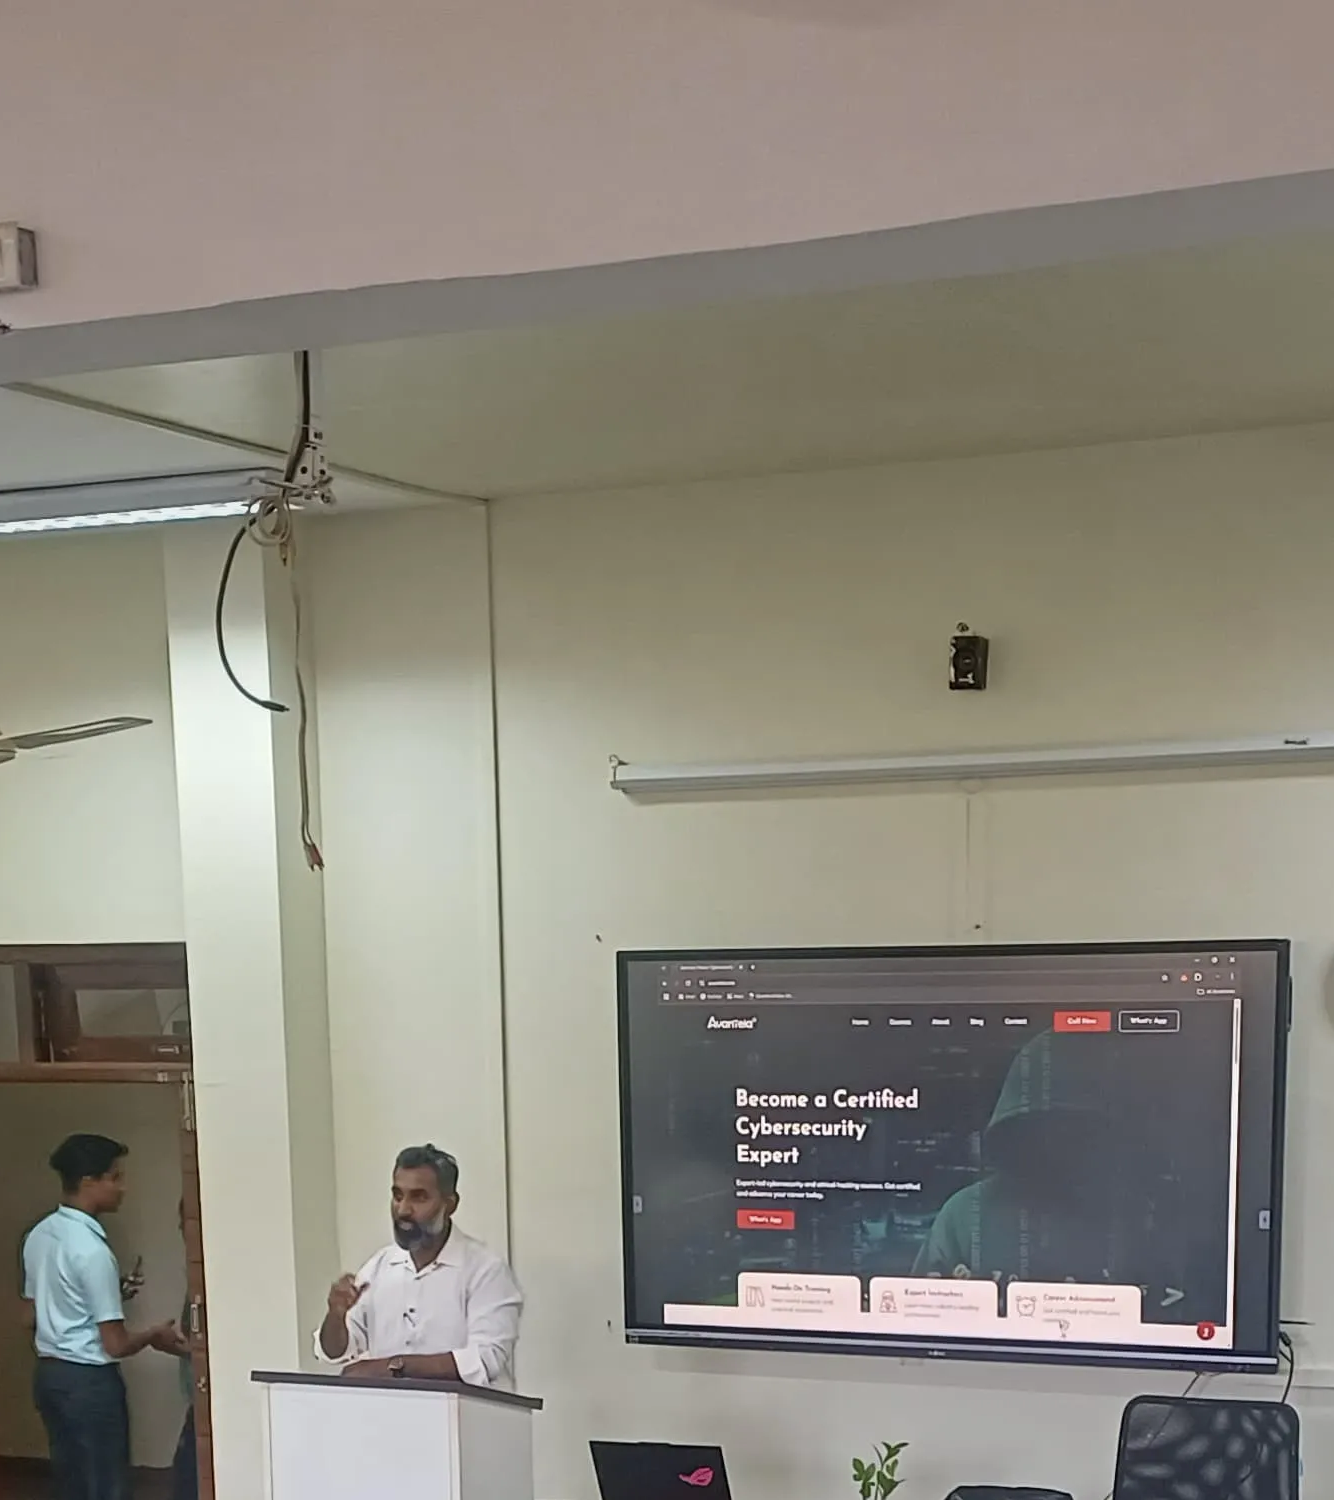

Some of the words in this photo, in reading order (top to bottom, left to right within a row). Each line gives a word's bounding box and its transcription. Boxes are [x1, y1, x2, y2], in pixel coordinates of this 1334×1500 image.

[735, 1087, 808, 1108] Become
[814, 1094, 827, 1108] a
[833, 1087, 919, 1109] Certified
[735, 1115, 867, 1141] Cybersecurity
[736, 1144, 799, 1167] Expert
